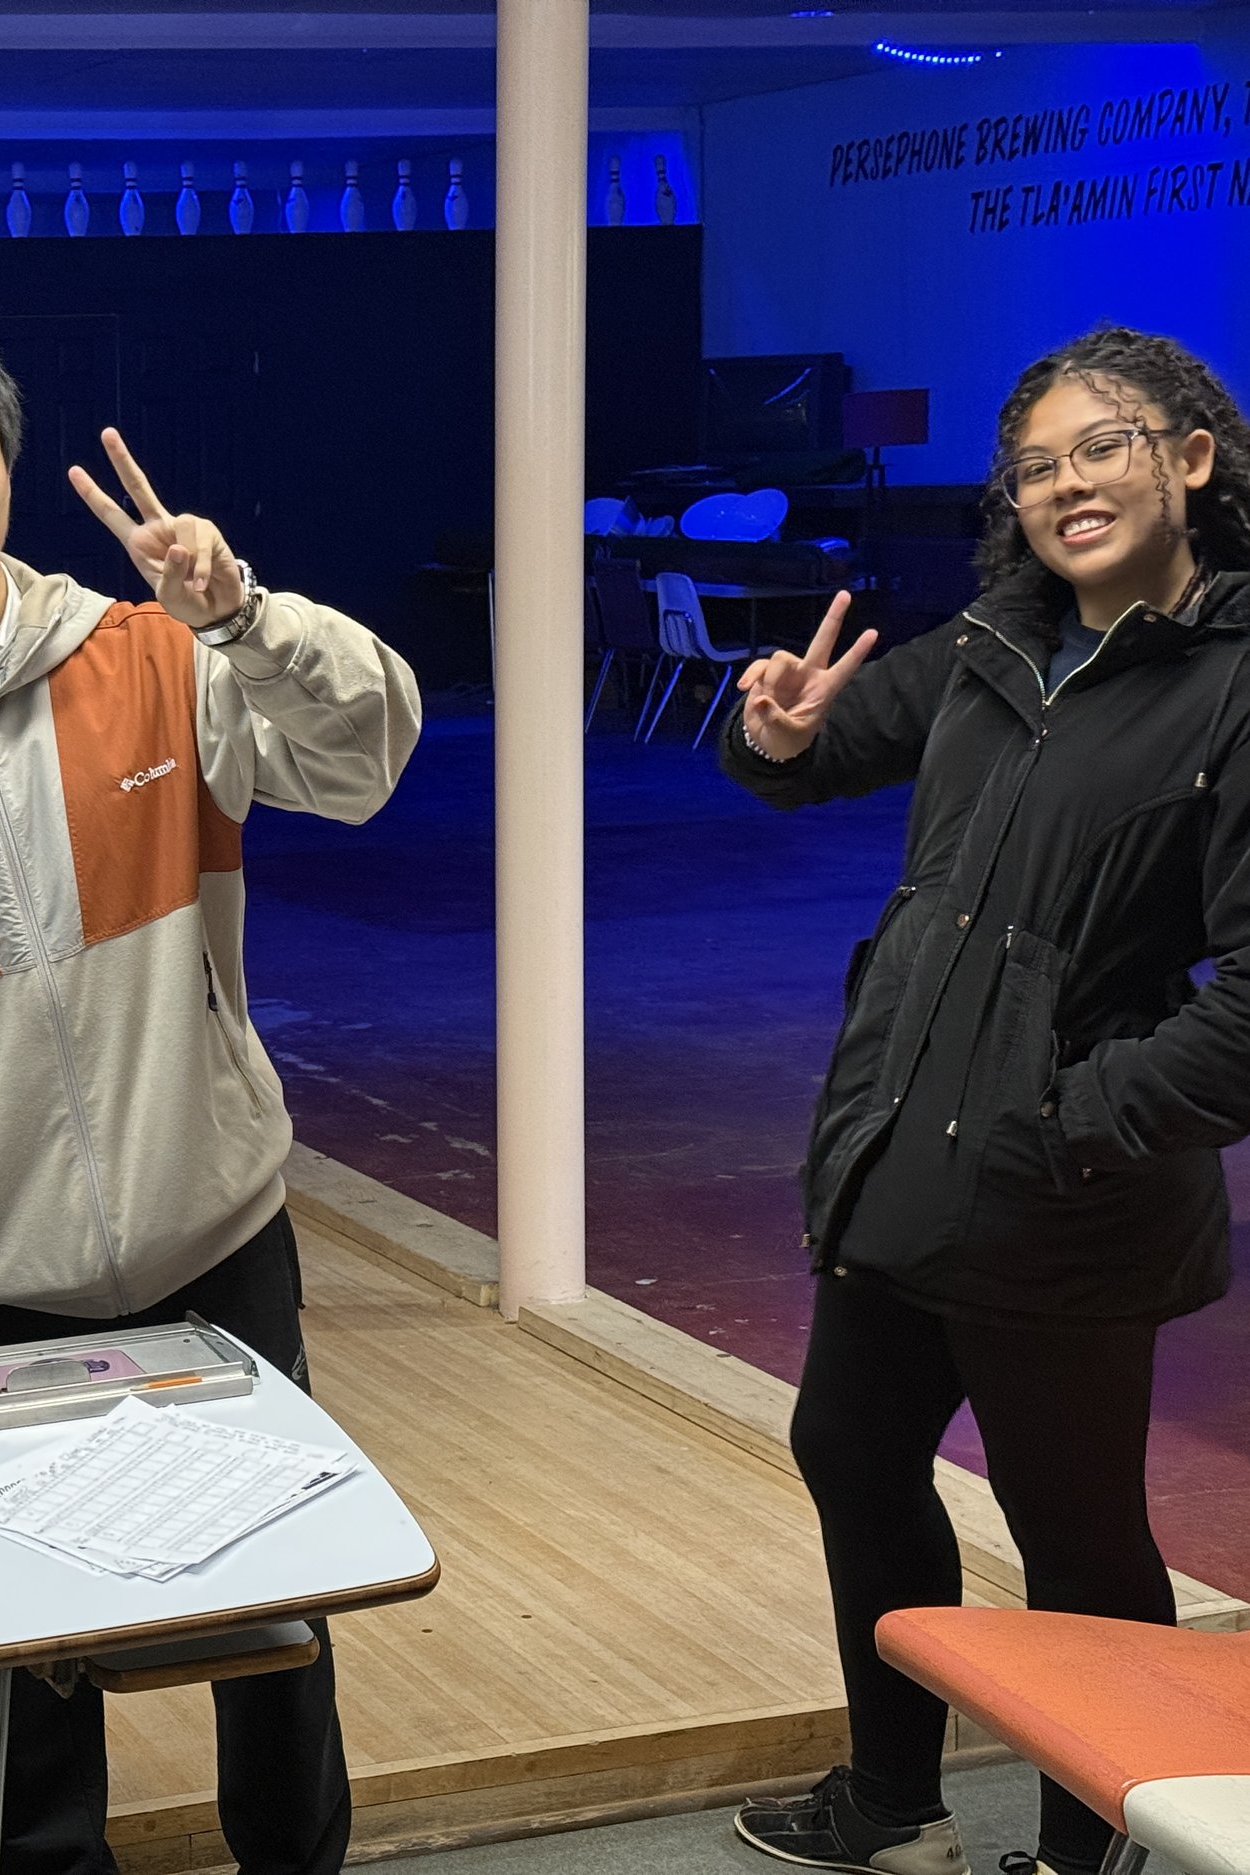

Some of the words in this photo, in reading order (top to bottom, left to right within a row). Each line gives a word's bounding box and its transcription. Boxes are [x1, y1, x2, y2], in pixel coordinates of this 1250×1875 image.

[829, 122, 969, 188] PERSEPHONE
[974, 104, 1091, 167] BREWING
[1097, 82, 1231, 147] COMPANY,
[969, 185, 1014, 234] THE
[1020, 172, 1138, 228] TLA'AMIN
[1143, 163, 1223, 216] FIRST
